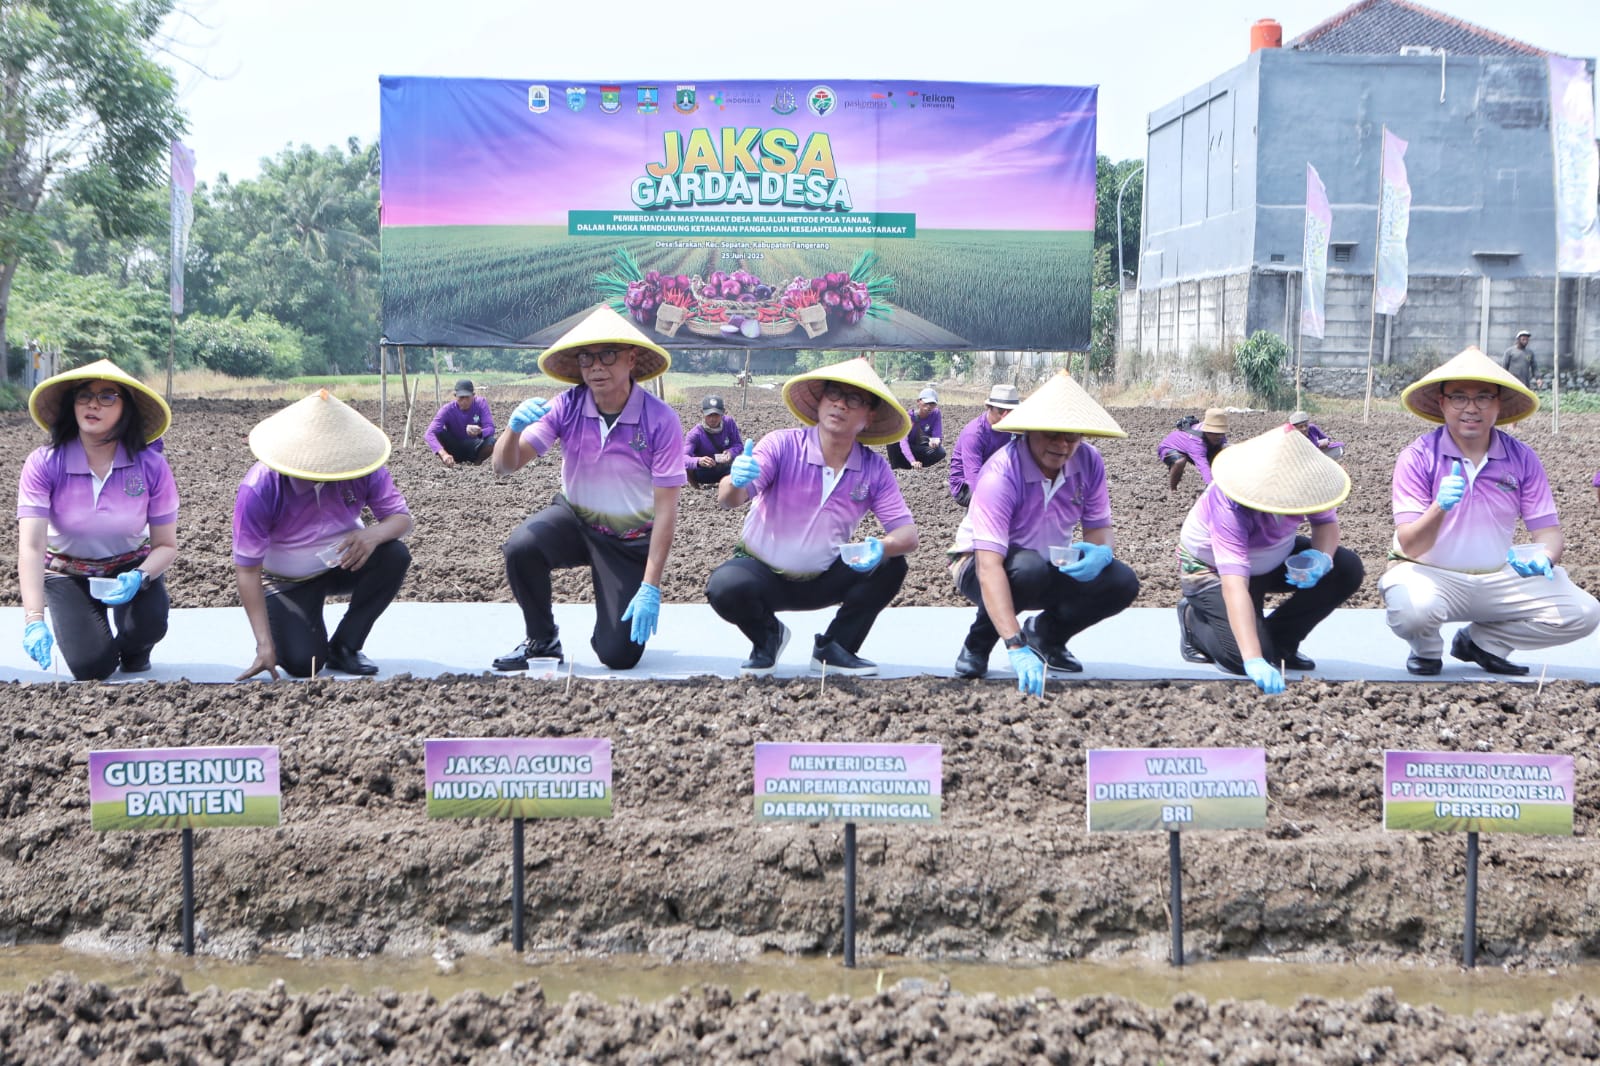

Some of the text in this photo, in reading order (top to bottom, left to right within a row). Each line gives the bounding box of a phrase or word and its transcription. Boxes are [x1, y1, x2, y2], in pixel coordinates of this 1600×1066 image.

[922, 93, 955, 103] Telkom
[922, 102, 955, 110] University
[646, 127, 837, 181] JAKSA
[631, 172, 853, 210] GARDA DESA
[576, 224, 605, 232] DALAM
[639, 225, 690, 233] MENDUKUNG
[691, 225, 738, 233] KETAHANAN
[739, 225, 772, 233] PANGAN
[855, 226, 907, 234] MASYARAKAT
[612, 214, 676, 223] PEMBERDAYAAN
[677, 215, 730, 223] MASYARAKAT
[752, 216, 786, 224] MELALUI
[841, 217, 872, 225] TANAM,
[655, 240, 673, 248] Desa
[752, 241, 791, 250] Kabupaten
[792, 241, 830, 251] Tangerang
[732, 251, 746, 260] Juni
[104, 757, 265, 787] GUBERNUR
[444, 755, 592, 775] JAKSA AGUNG
[789, 756, 906, 772] MENTERI DESA
[1145, 757, 1208, 776] WAKIL
[1405, 762, 1552, 781] DIREKTUR UTAMA
[432, 780, 605, 800] MUDA INTELIJEN
[765, 779, 931, 796] DAN PEMBANGUNAN
[1094, 780, 1261, 801] DIREKTUR UTAMA
[1390, 781, 1566, 801] PT PUPUK INDONESIA
[125, 789, 244, 818] BANTEN
[763, 802, 932, 819] DAERAH TERTINGGAL
[1434, 802, 1521, 821] (PERSERO)
[1161, 805, 1193, 823] BRI
